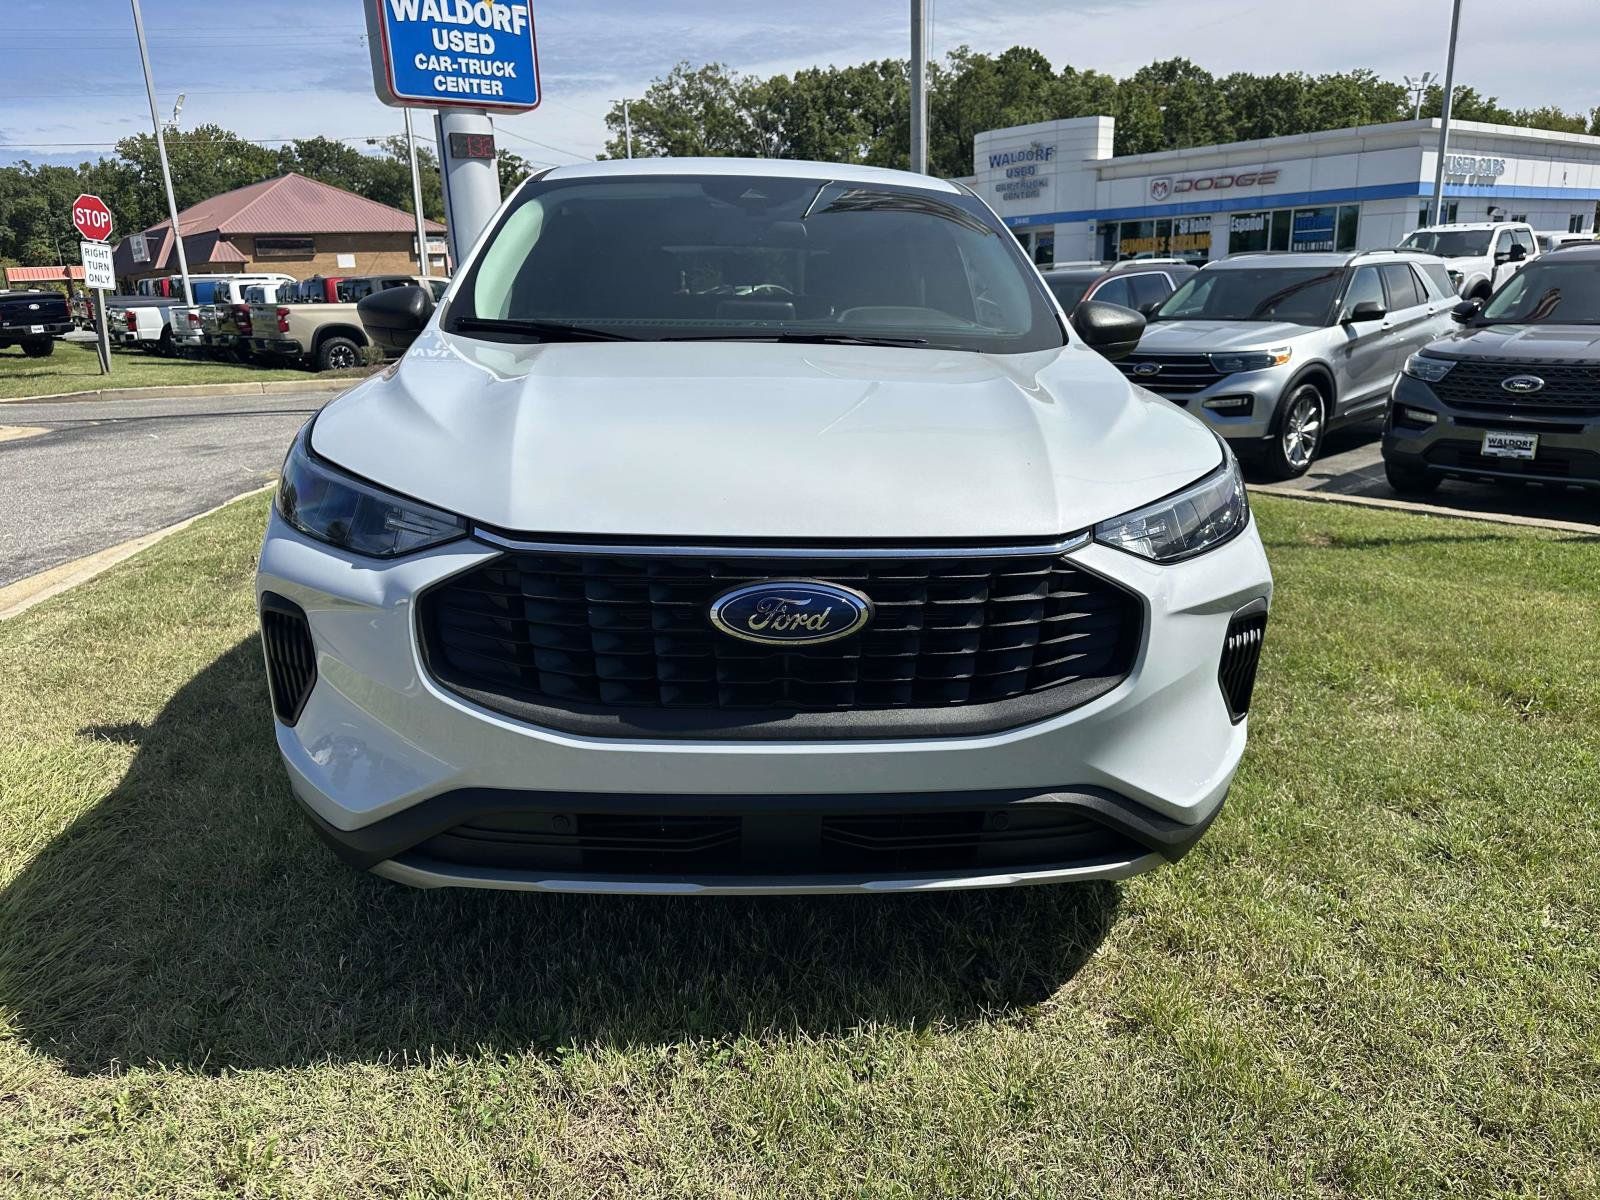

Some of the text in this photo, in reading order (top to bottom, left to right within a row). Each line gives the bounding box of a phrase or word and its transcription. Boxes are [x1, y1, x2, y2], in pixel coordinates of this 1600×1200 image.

[390, 0, 527, 35] WALDORF
[432, 28, 495, 55] USED
[414, 53, 517, 78] CAR-TRUCK
[434, 75, 503, 95] CENTER
[988, 147, 1055, 168] WALDORF
[1445, 155, 1506, 177] USED CARS
[1006, 165, 1036, 178] USED
[1173, 170, 1281, 193] DODGE
[75, 207, 109, 228] STOP
[84, 247, 109, 258] RIGHT
[87, 261, 110, 271] TURN
[88, 273, 110, 284] ONLY
[1488, 438, 1534, 448] WALDORF
[748, 597, 832, 631] Ford
